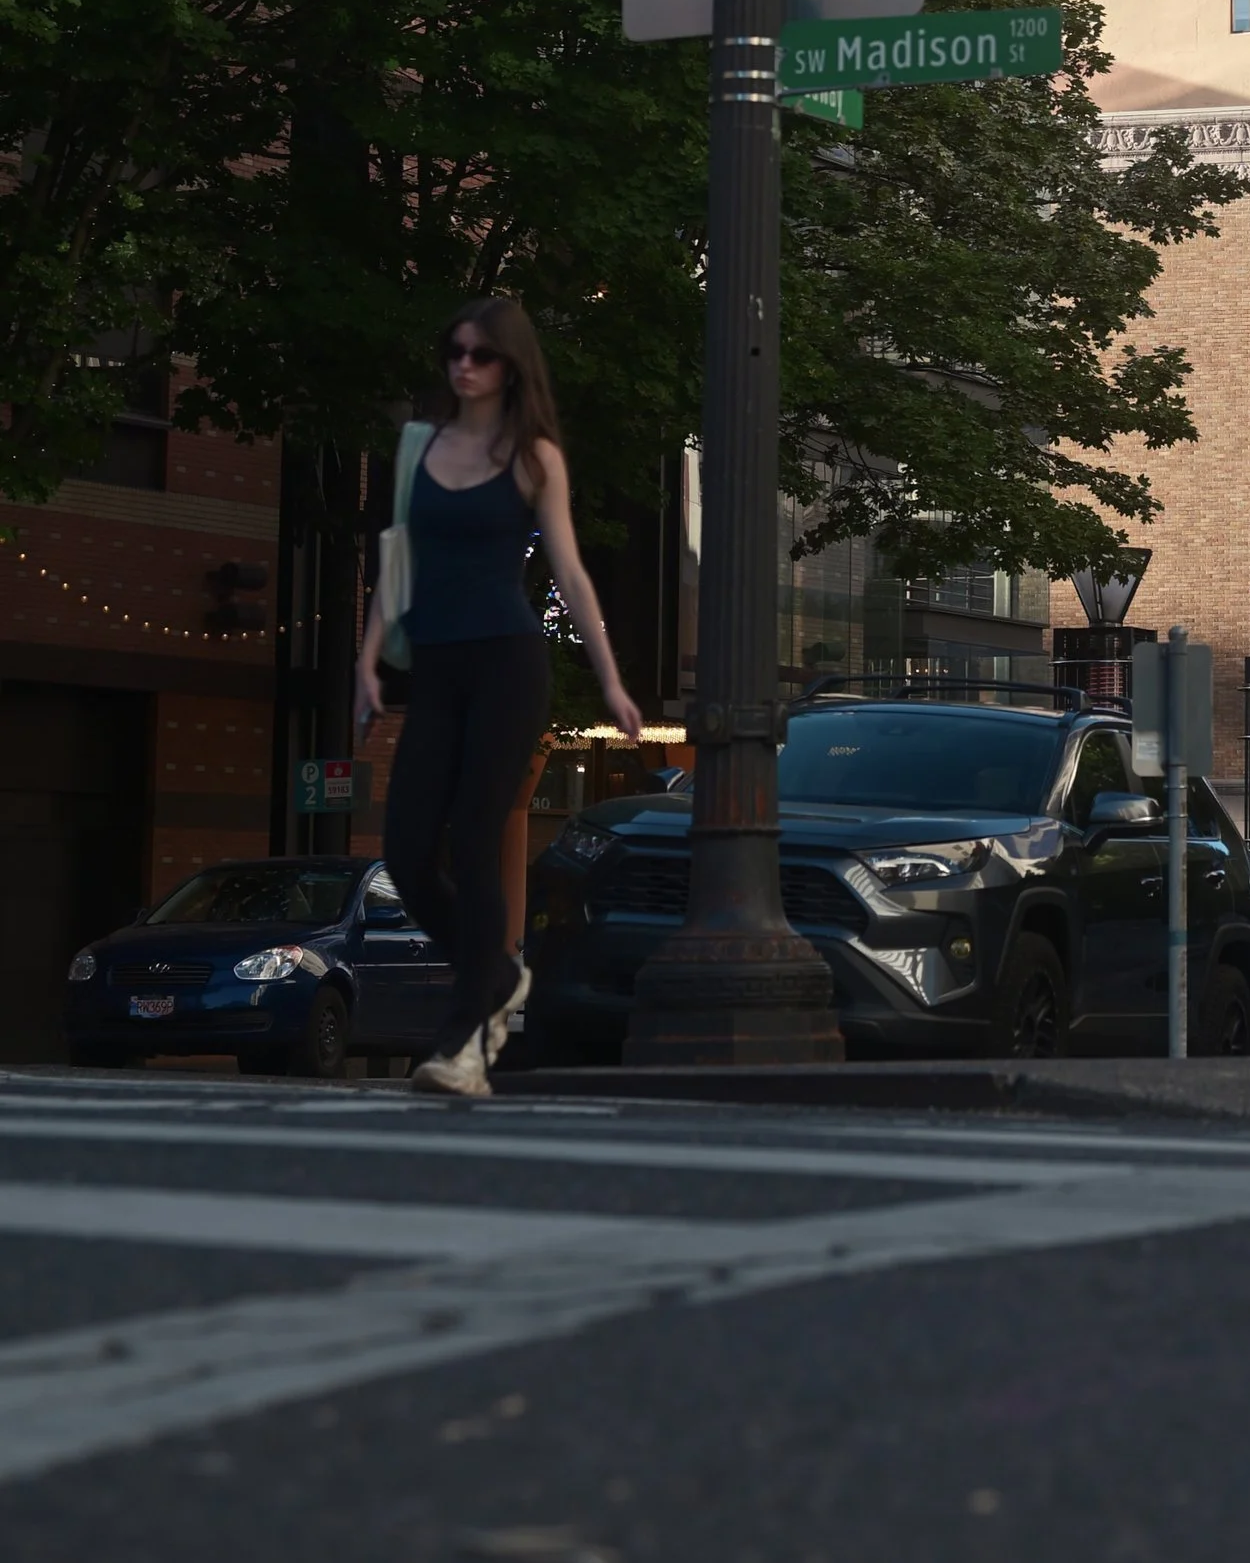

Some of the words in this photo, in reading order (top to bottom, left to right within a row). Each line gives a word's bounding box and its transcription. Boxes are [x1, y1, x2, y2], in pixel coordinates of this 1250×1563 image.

[1008, 17, 1047, 37] 1200
[794, 49, 825, 74] SW
[836, 29, 997, 71] Madison
[1008, 44, 1025, 63] St
[304, 786, 317, 805] 2
